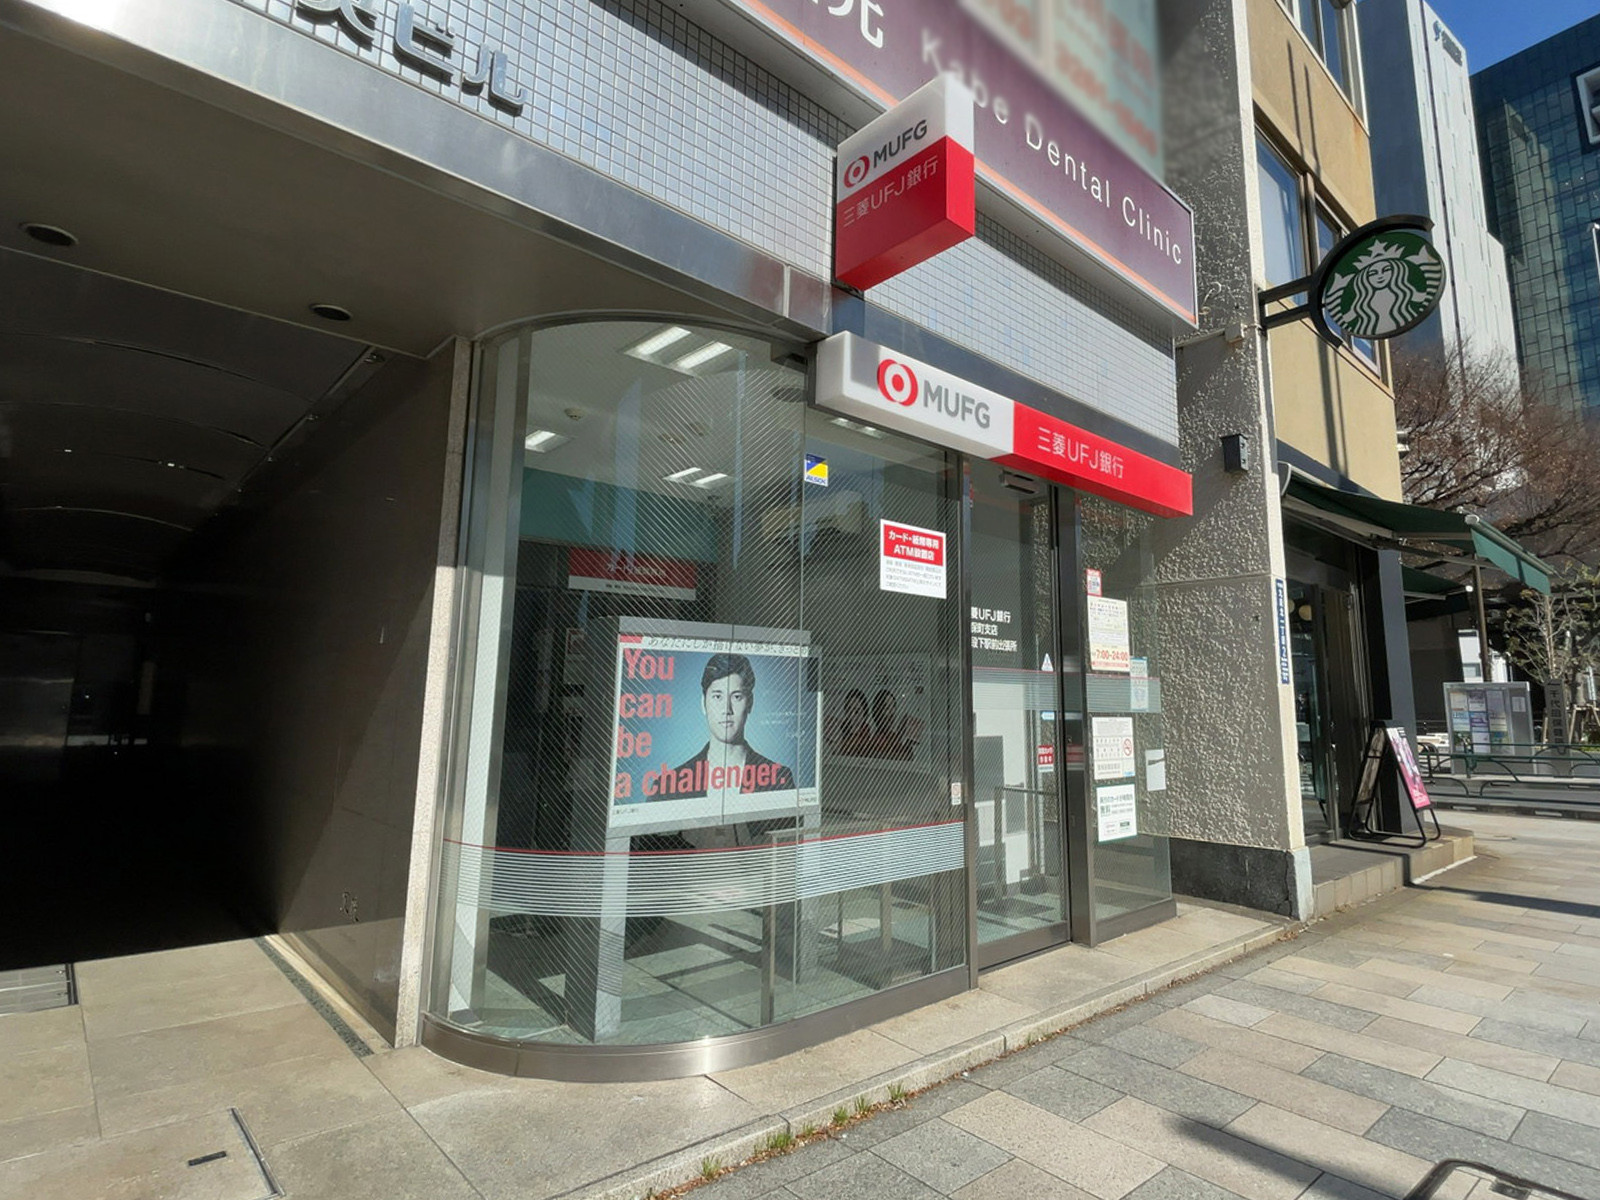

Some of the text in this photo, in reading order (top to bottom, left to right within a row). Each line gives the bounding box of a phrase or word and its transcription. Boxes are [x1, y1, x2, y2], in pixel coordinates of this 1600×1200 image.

[873, 119, 928, 169] MUFG
[843, 155, 939, 228] 三菱UFJ銀行
[1025, 113, 1110, 208] Dental
[1122, 196, 1182, 265] Clinic
[923, 379, 991, 430] MUFG
[1037, 426, 1125, 479] 三菱UFJ銀行
[622, 648, 675, 680] You
[619, 692, 674, 718] can
[616, 725, 653, 758] be
[614, 759, 787, 798] a challenger.
